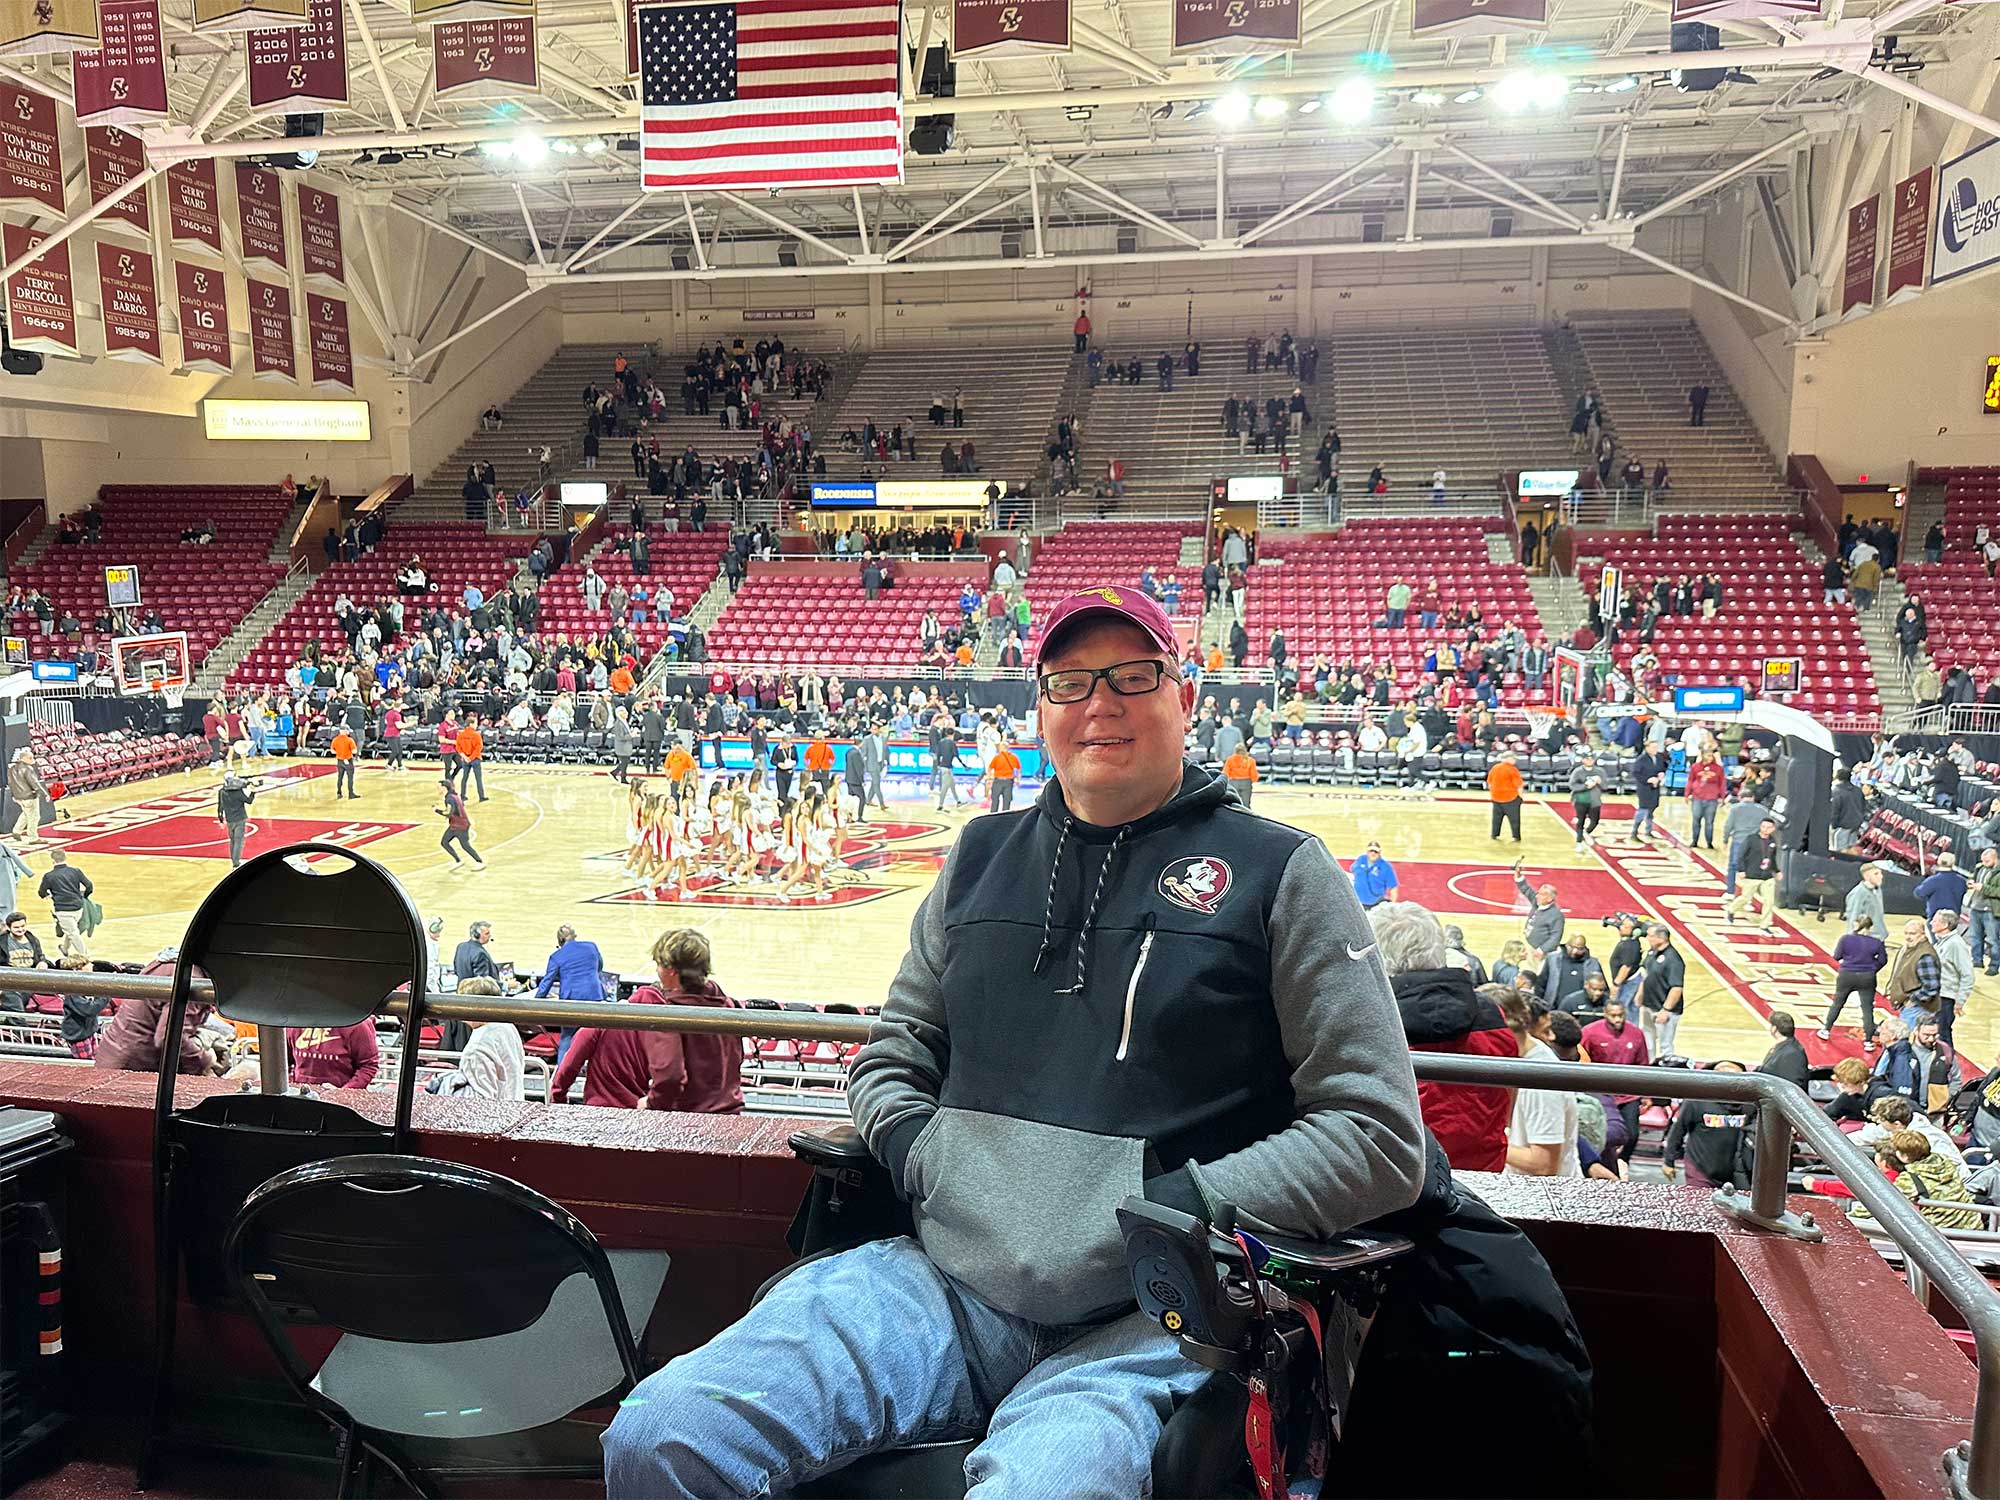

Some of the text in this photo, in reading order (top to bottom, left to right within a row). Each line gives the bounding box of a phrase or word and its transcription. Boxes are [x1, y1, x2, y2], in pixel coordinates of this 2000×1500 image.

[310, 8, 333, 18] 010
[1183, 3, 1213, 12] 1964
[104, 13, 124, 21] 1959
[132, 11, 152, 19] 1978
[133, 23, 153, 31] 1985
[299, 22, 333, 33] 2012
[441, 26, 463, 35] 1956
[471, 23, 494, 32] 1984
[502, 22, 523, 30] 1991
[105, 36, 126, 44] 1965
[134, 34, 154, 42] 1990
[300, 36, 334, 47] 2014
[442, 38, 464, 46] 1959
[472, 35, 494, 44] 1985
[503, 34, 526, 42] 1998
[134, 45, 155, 53] 1998
[254, 39, 288, 50] 2006
[503, 46, 526, 54] 1999
[106, 47, 127, 55] 1968
[301, 50, 335, 61] 2016
[443, 49, 465, 58] 1963
[79, 60, 99, 68] 1956
[107, 58, 127, 66] 1973
[135, 57, 156, 65] 1999
[255, 53, 288, 64] 2007
[1, 132, 24, 147] TOM
[28, 130, 56, 142] JERSEY
[7, 146, 50, 167] MARTIN
[89, 145, 142, 167] RETIRED JERSEY
[26, 166, 55, 179] HOCKEY
[108, 161, 127, 175] BILL
[11, 174, 52, 193] 1958-61
[168, 171, 193, 184] RETIRED
[180, 184, 205, 199] GERRY
[113, 200, 138, 213] 58-61
[181, 195, 207, 211] WARD
[252, 206, 270, 219] JOHN
[246, 214, 278, 232] CUNNIFF
[1972, 211, 2000, 236] EAST
[307, 224, 335, 239] MICHAEL
[310, 234, 334, 248] ADAMS
[42, 270, 68, 281] JERSEY
[25, 276, 55, 292] TERRY
[102, 276, 152, 292] RETIRED JERSEY
[16, 286, 67, 306] DRISCOLL
[116, 290, 143, 304] DANA
[113, 300, 148, 316] BARROS
[180, 295, 225, 312] DAVID EMMA
[12, 301, 72, 319] MEN'S BASKETBALL
[22, 315, 65, 331] 1966-69
[106, 313, 156, 328] MEN'S BASKETBALL
[193, 309, 215, 329] 16
[261, 317, 283, 330] SARAH
[263, 327, 283, 339] BEHN
[321, 332, 338, 343] MIKE
[316, 340, 345, 354] MOTTAU
[1937, 426, 1948, 436] P
